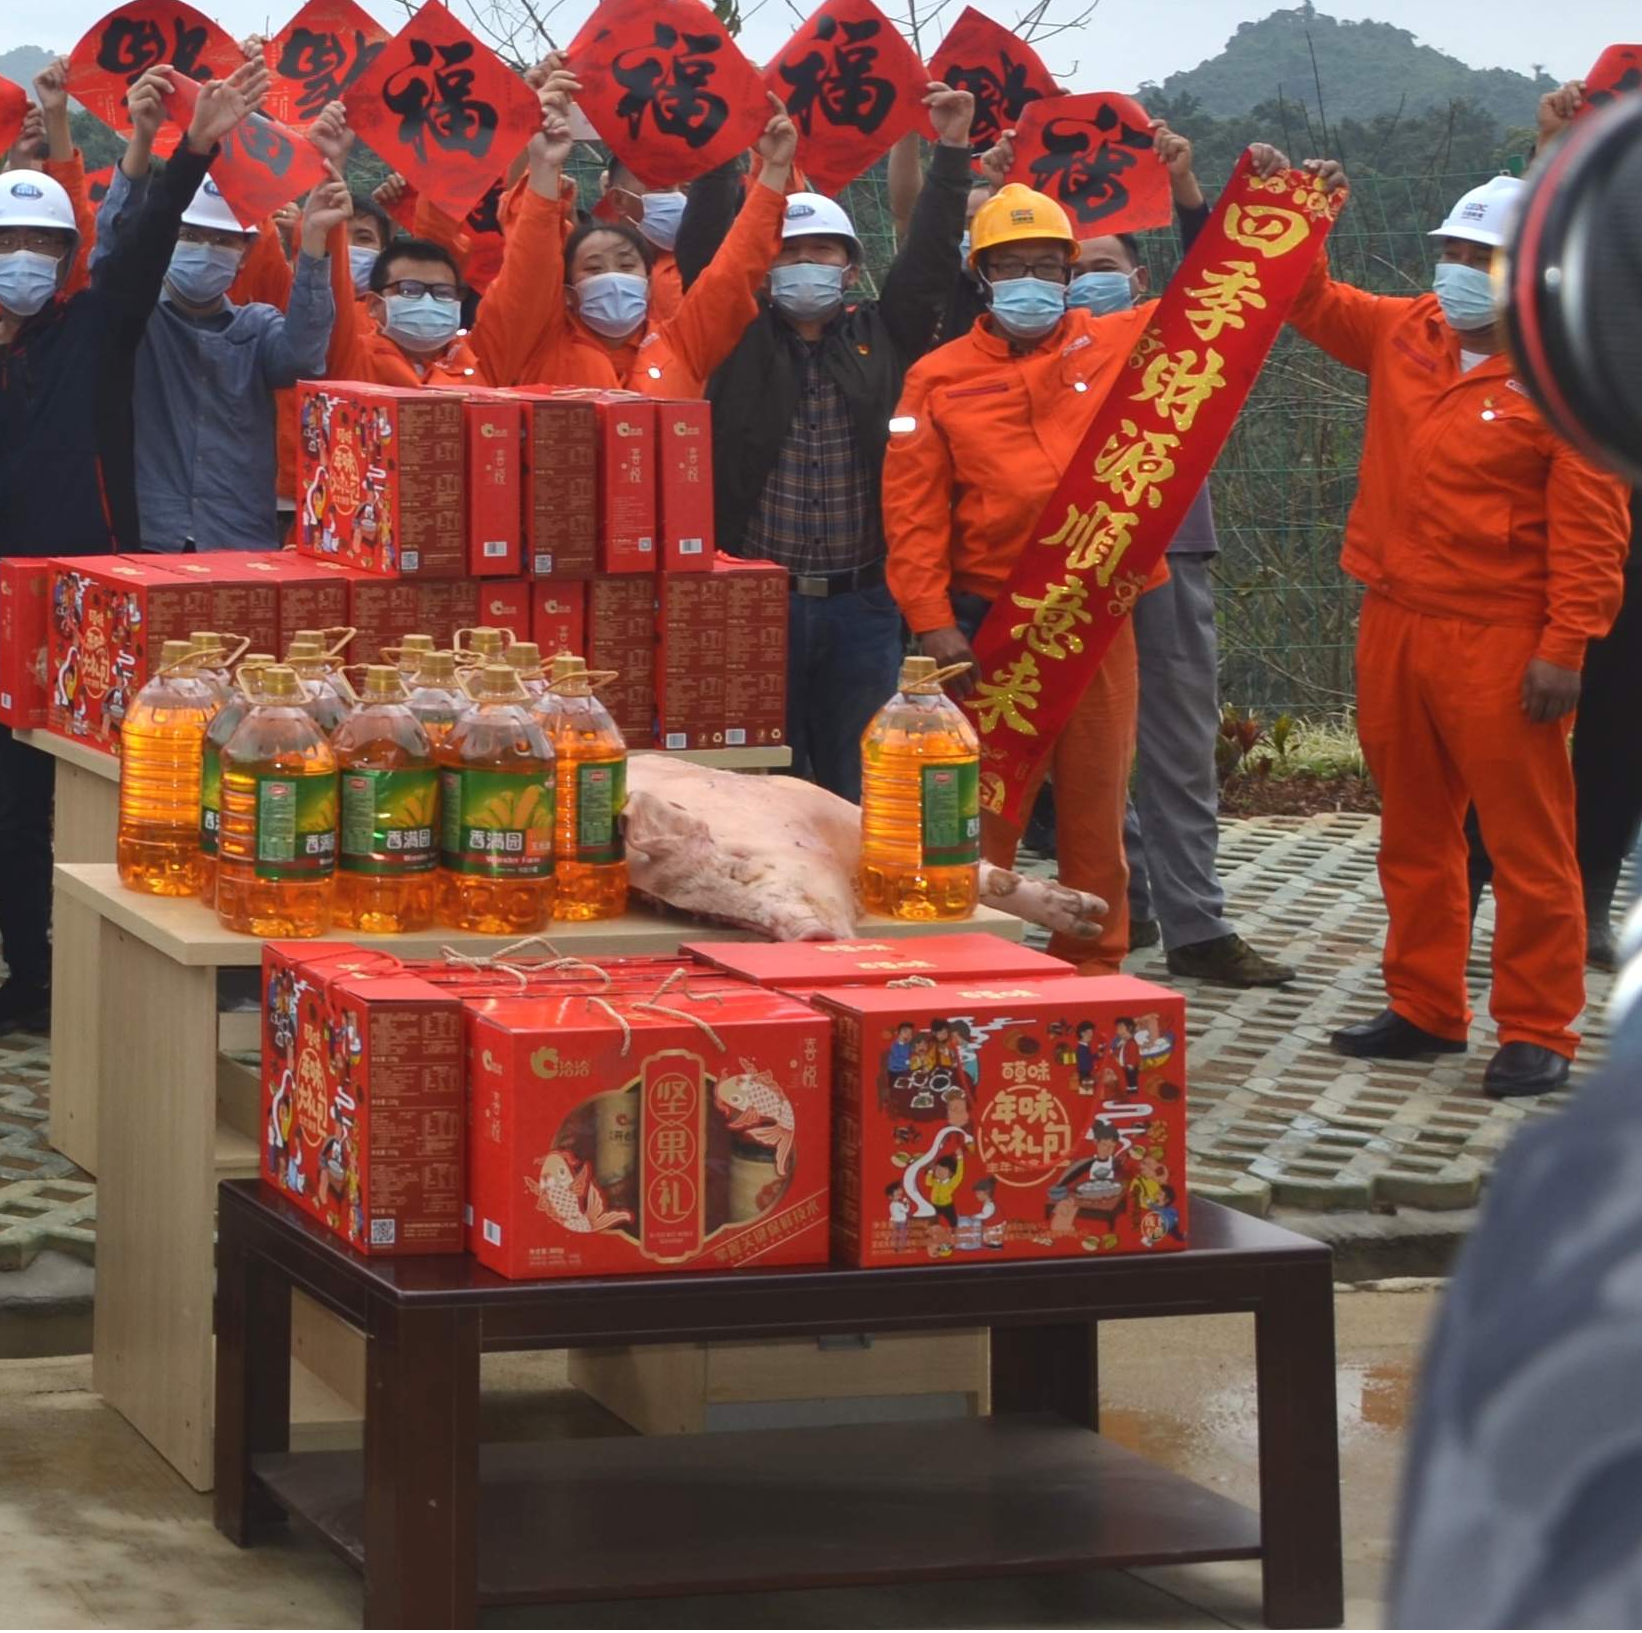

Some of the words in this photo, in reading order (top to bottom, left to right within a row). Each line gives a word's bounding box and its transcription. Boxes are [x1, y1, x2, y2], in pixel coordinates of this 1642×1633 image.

[384, 39, 500, 162] 福
[613, 22, 729, 149] 福
[781, 16, 896, 135] 福
[1030, 104, 1156, 226] 福
[991, 1088, 1058, 1124] 年味
[1001, 1059, 1051, 1083] 百草味
[656, 1080, 690, 1216] 坚果礼
